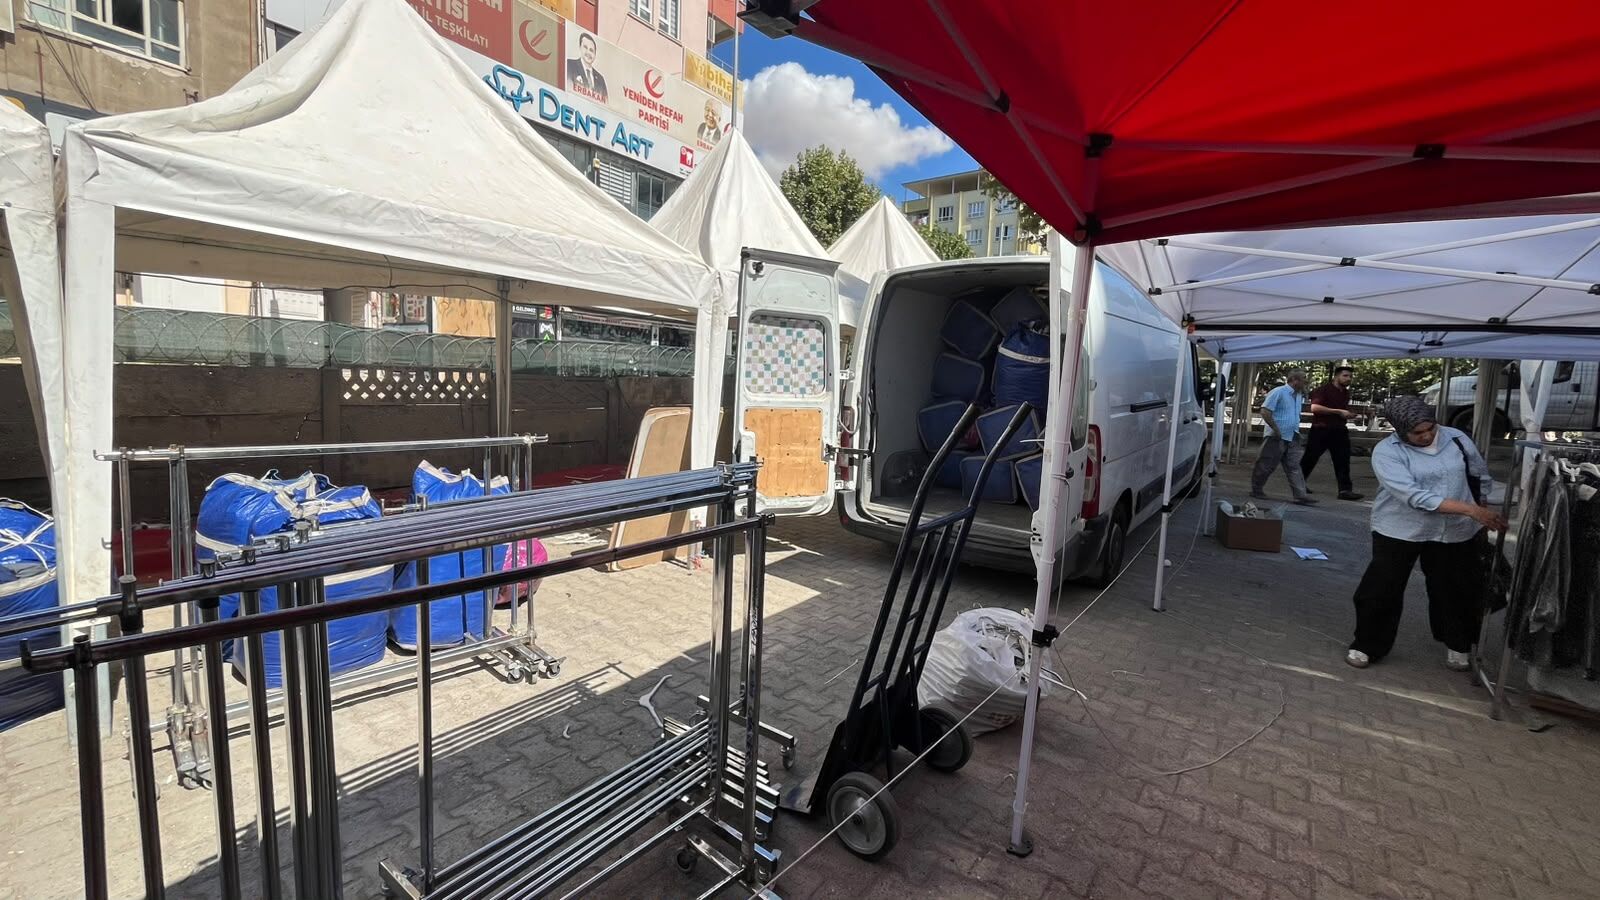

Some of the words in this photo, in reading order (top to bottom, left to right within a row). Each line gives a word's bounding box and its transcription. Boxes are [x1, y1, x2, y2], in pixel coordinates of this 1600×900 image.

[435, 15, 488, 48] TEŞKİLATI
[573, 83, 607, 104] ERBAKAN
[623, 86, 657, 111] YENİDEN
[659, 104, 683, 124] REFAH
[539, 87, 606, 141] DENT
[611, 122, 654, 160] ART
[639, 109, 669, 131] PARTİSİ
